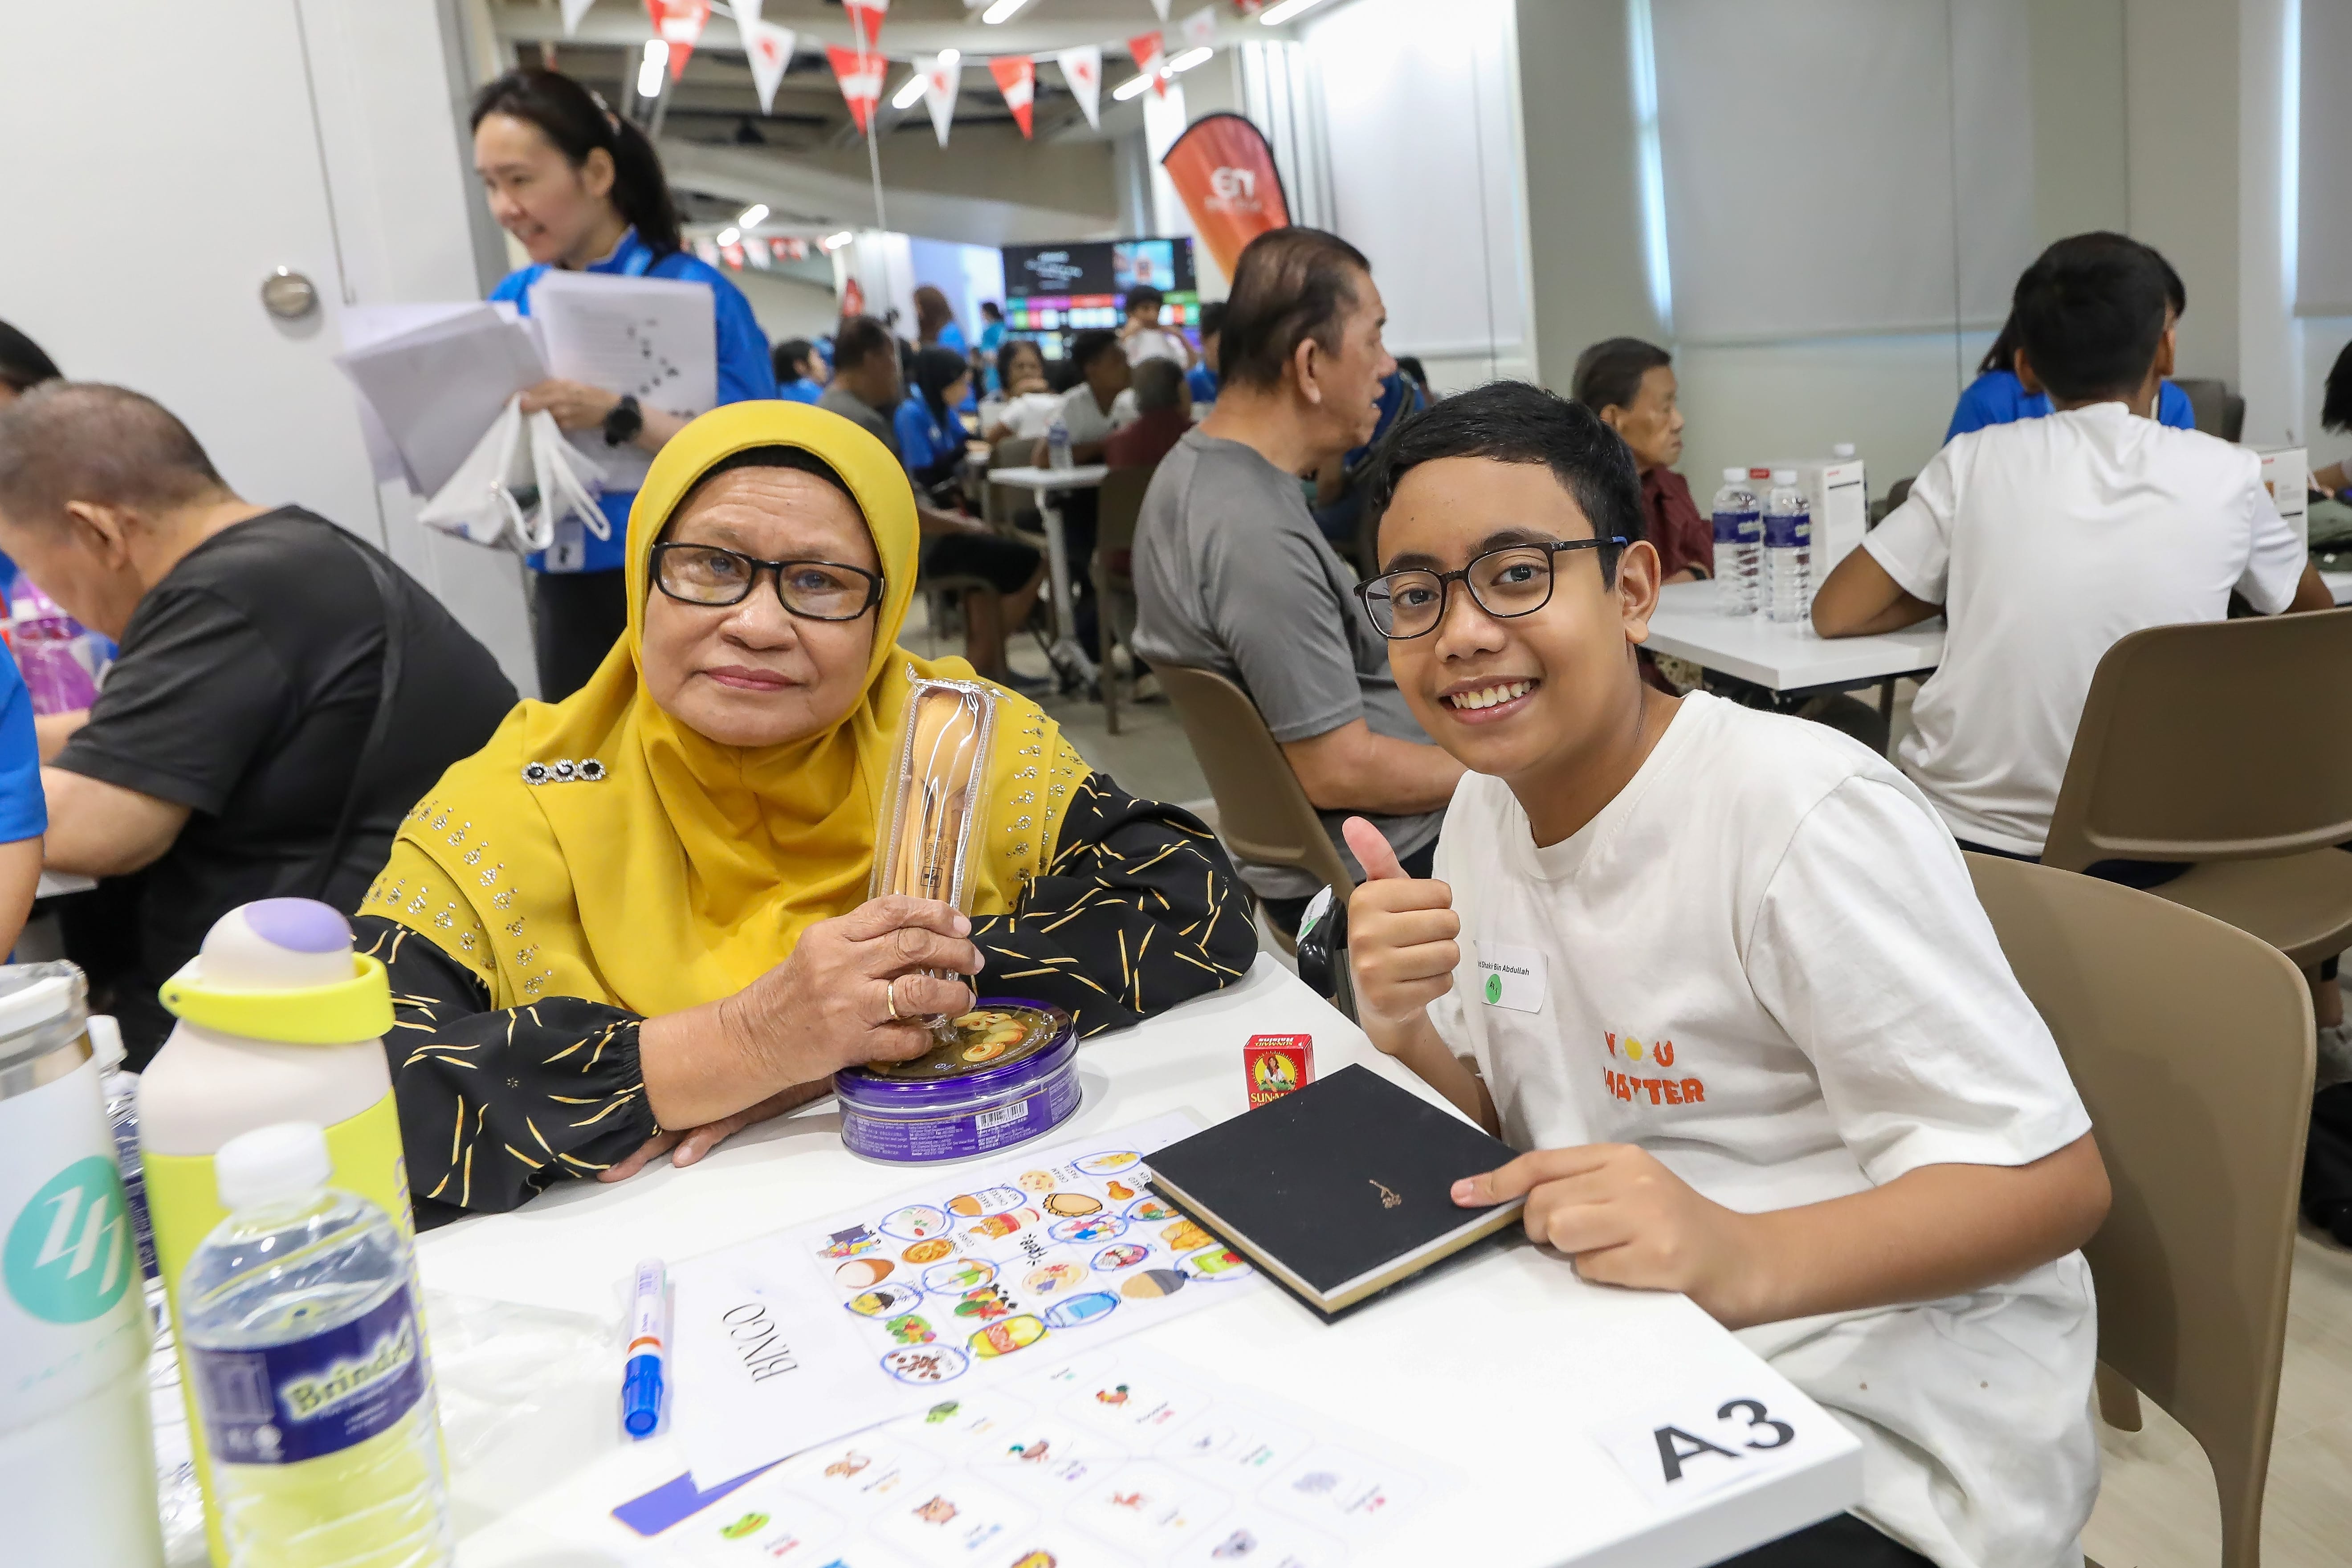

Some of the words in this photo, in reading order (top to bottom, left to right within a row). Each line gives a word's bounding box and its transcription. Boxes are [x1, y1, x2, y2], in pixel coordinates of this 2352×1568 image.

[1502, 965, 1529, 976] Abdullah
[722, 1303, 799, 1383] BINGO
[1654, 1399, 1795, 1483] A3
